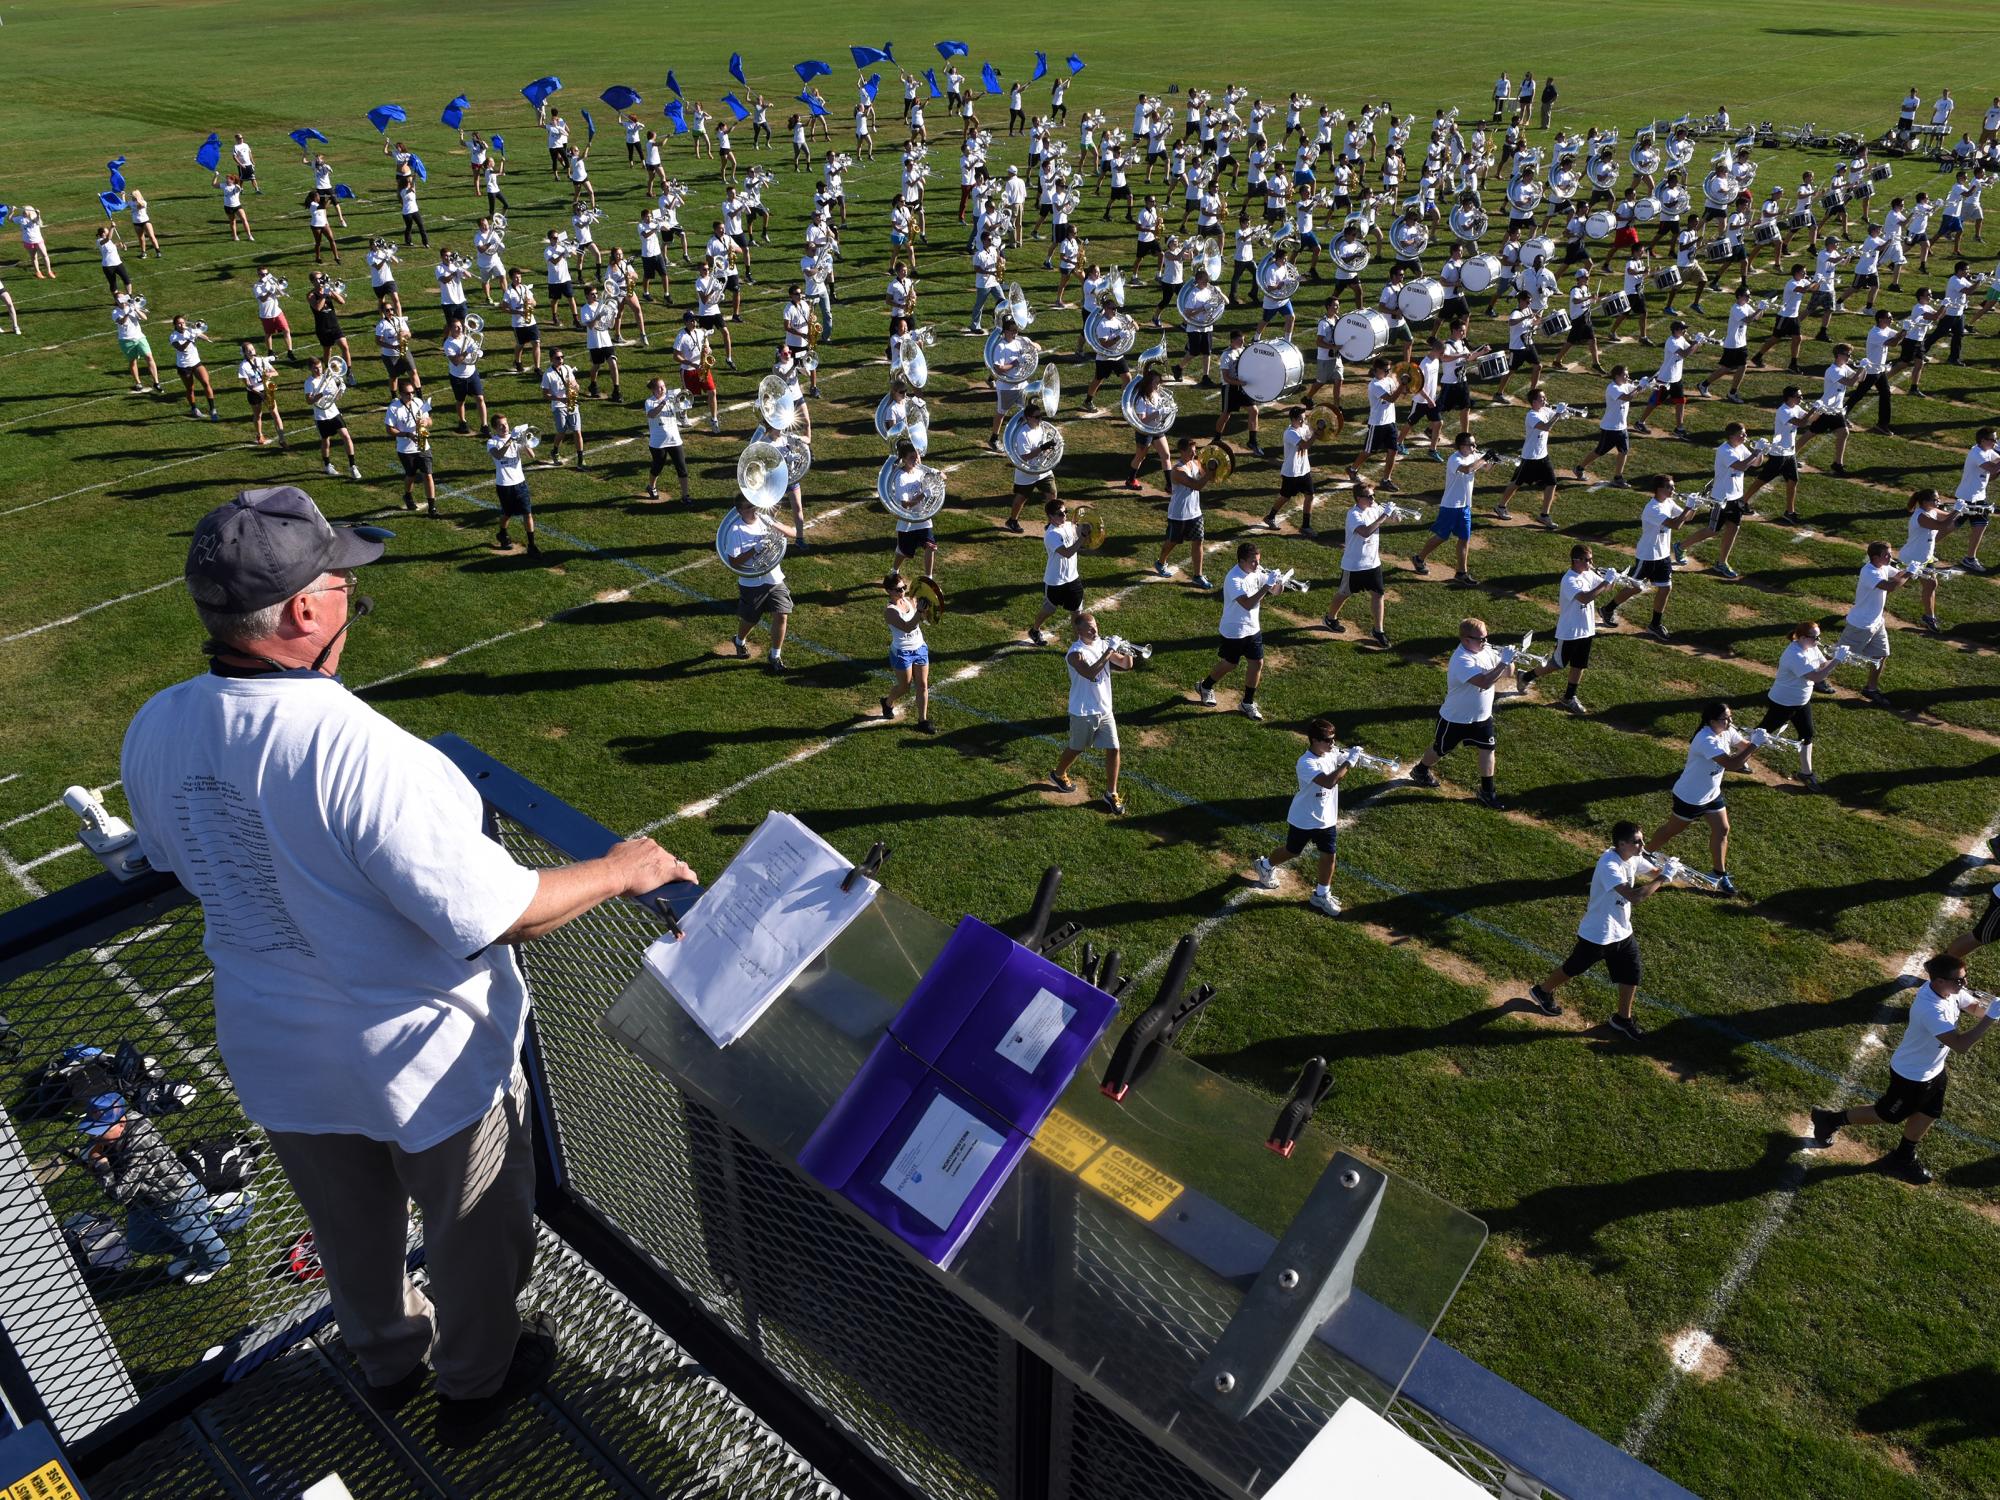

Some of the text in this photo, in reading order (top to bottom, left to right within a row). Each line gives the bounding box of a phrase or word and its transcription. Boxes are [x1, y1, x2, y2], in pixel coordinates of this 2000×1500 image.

[1050, 1111, 1101, 1147] AUTION
[1101, 1161, 1165, 1201] AUTHORIZED
[1112, 1150, 1178, 1193] CAUTION
[1096, 1168, 1154, 1208] PERSONNEL
[1100, 1182, 1136, 1207] ONLY!
[30, 1474, 48, 1497] WHEN
[46, 1467, 62, 1485] USE
[55, 1482, 68, 1494] IN
